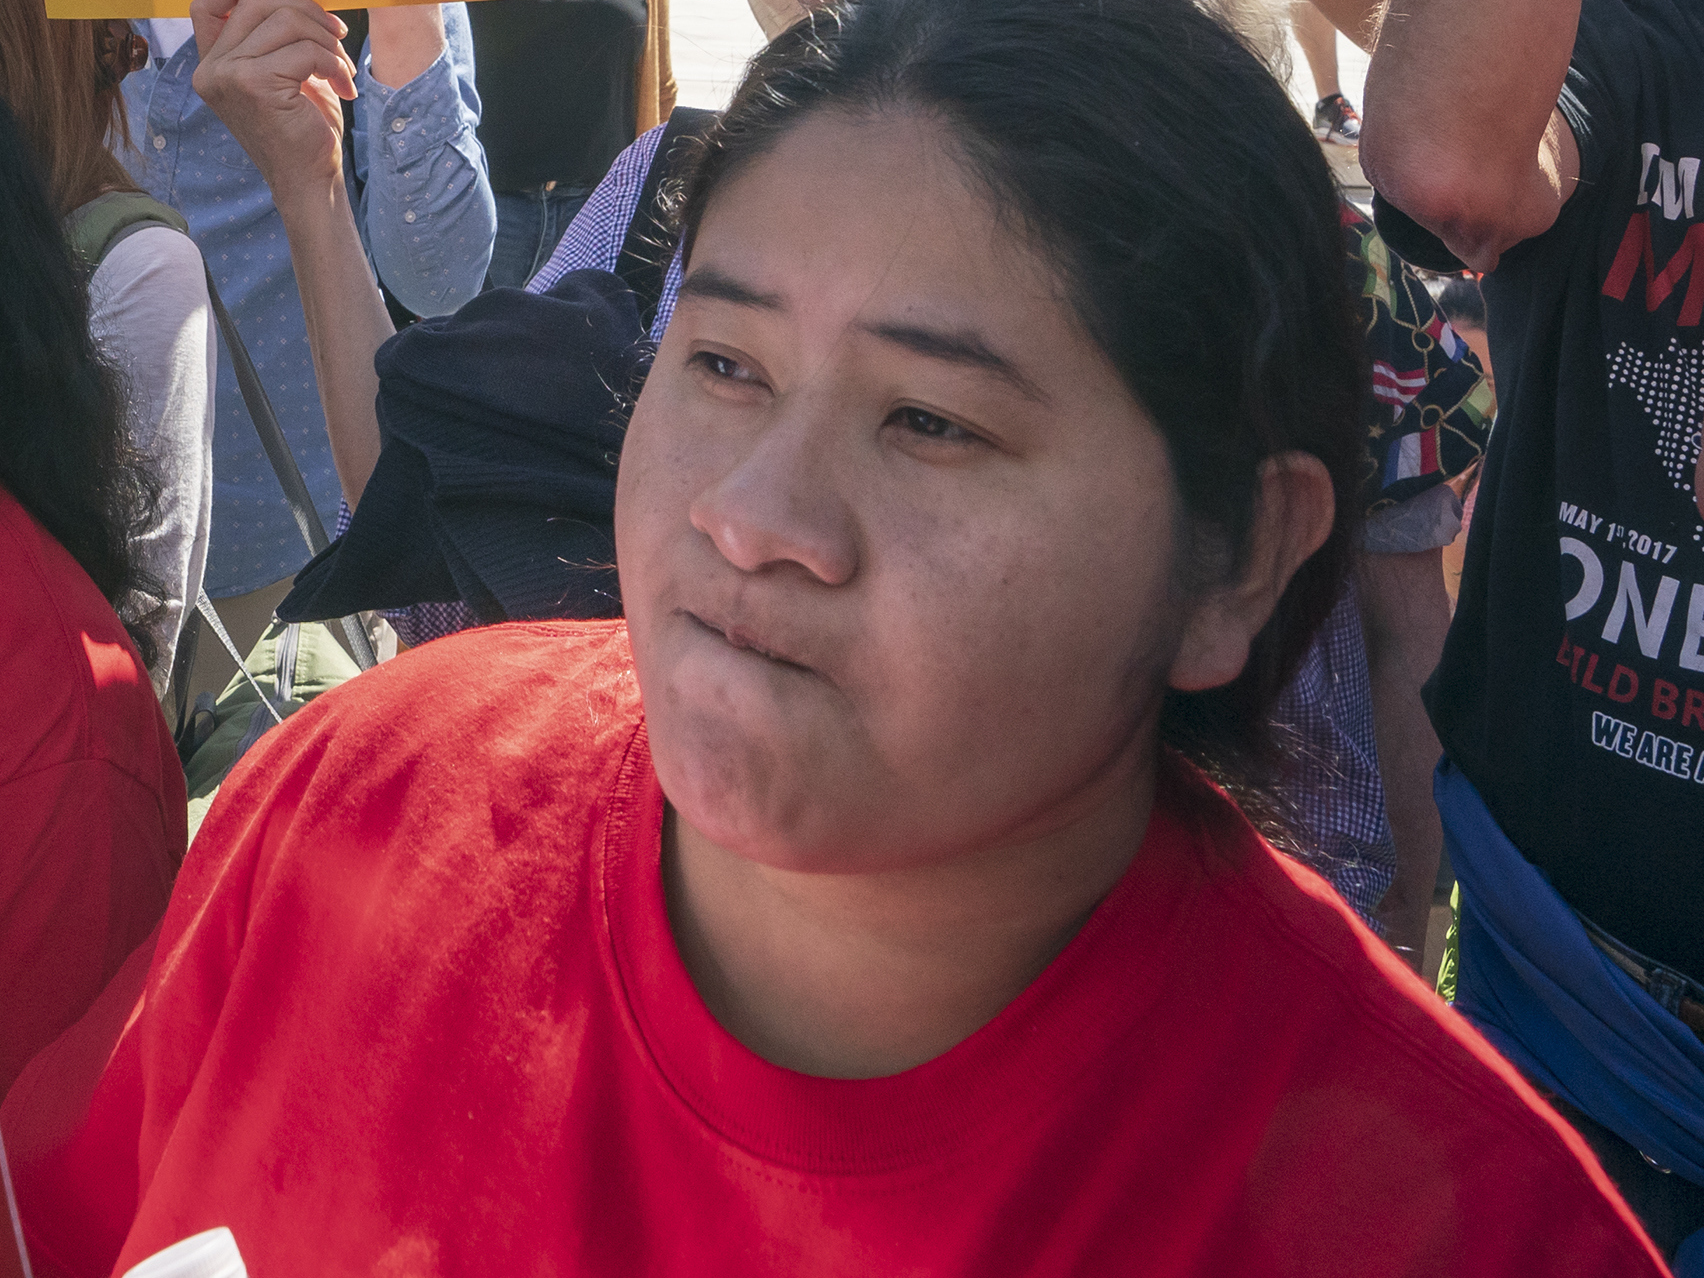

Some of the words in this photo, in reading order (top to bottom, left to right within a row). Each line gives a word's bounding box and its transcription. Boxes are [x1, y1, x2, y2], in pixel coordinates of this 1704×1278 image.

[1559, 501, 1603, 534] MAY
[1628, 530, 1677, 564] 2017
[1591, 711, 1637, 758] WE
[1636, 731, 1693, 780] ARE
